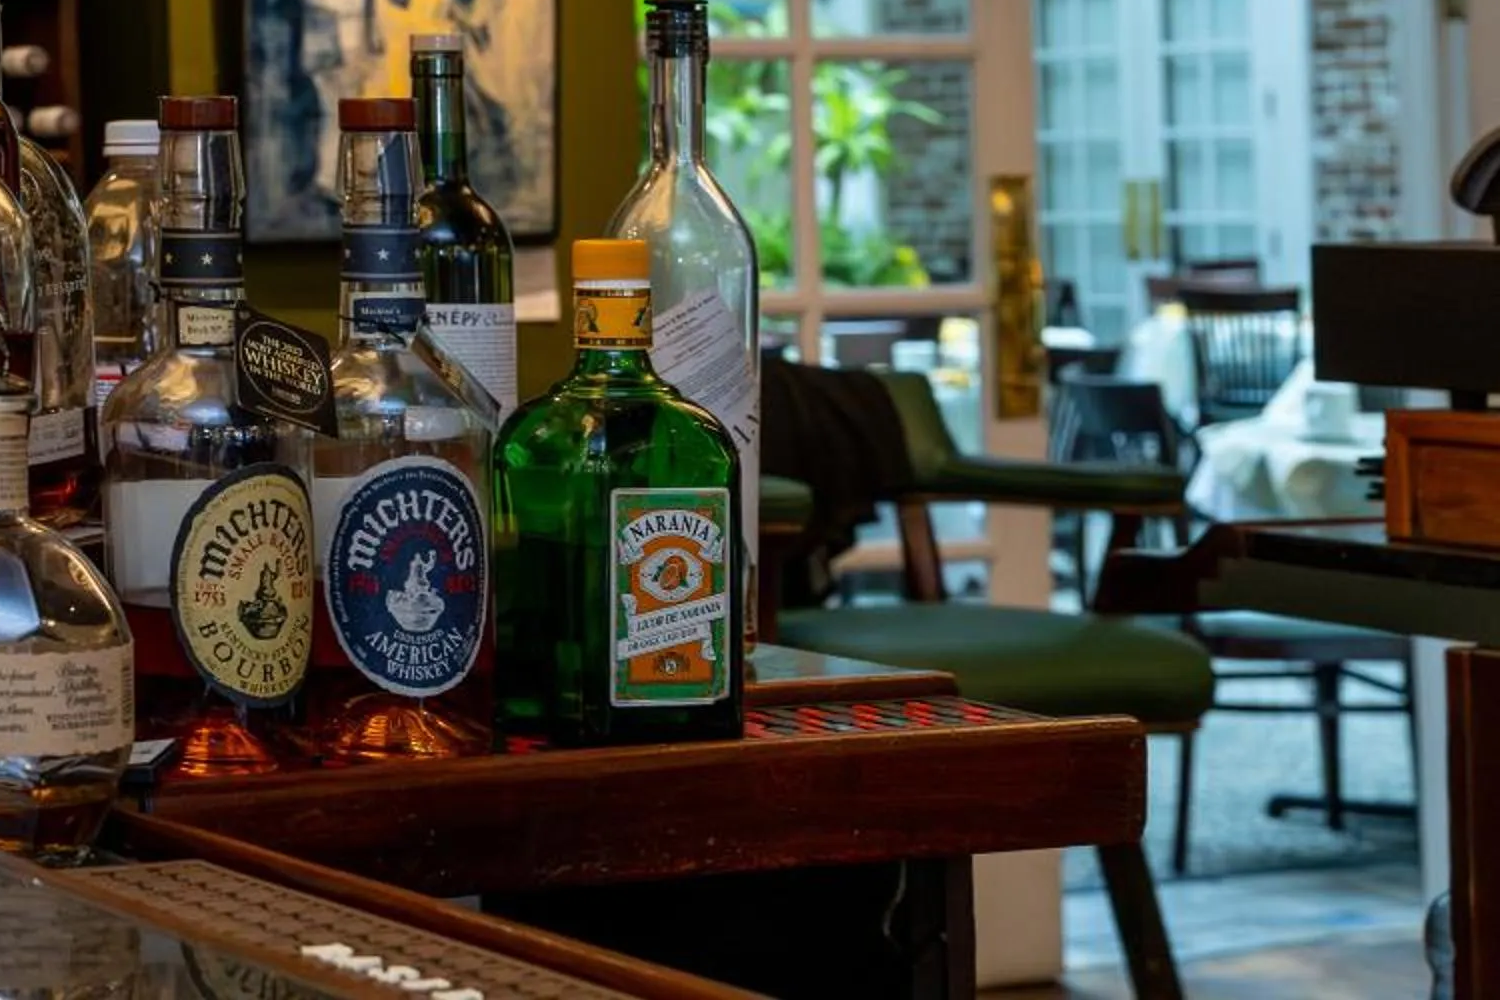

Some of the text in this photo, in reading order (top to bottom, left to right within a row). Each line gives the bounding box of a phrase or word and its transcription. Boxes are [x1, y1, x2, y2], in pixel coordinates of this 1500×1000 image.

[245, 347, 322, 385] WHISKEY
[365, 627, 463, 664] AMERICAN
[387, 660, 452, 681] WHISKEY
